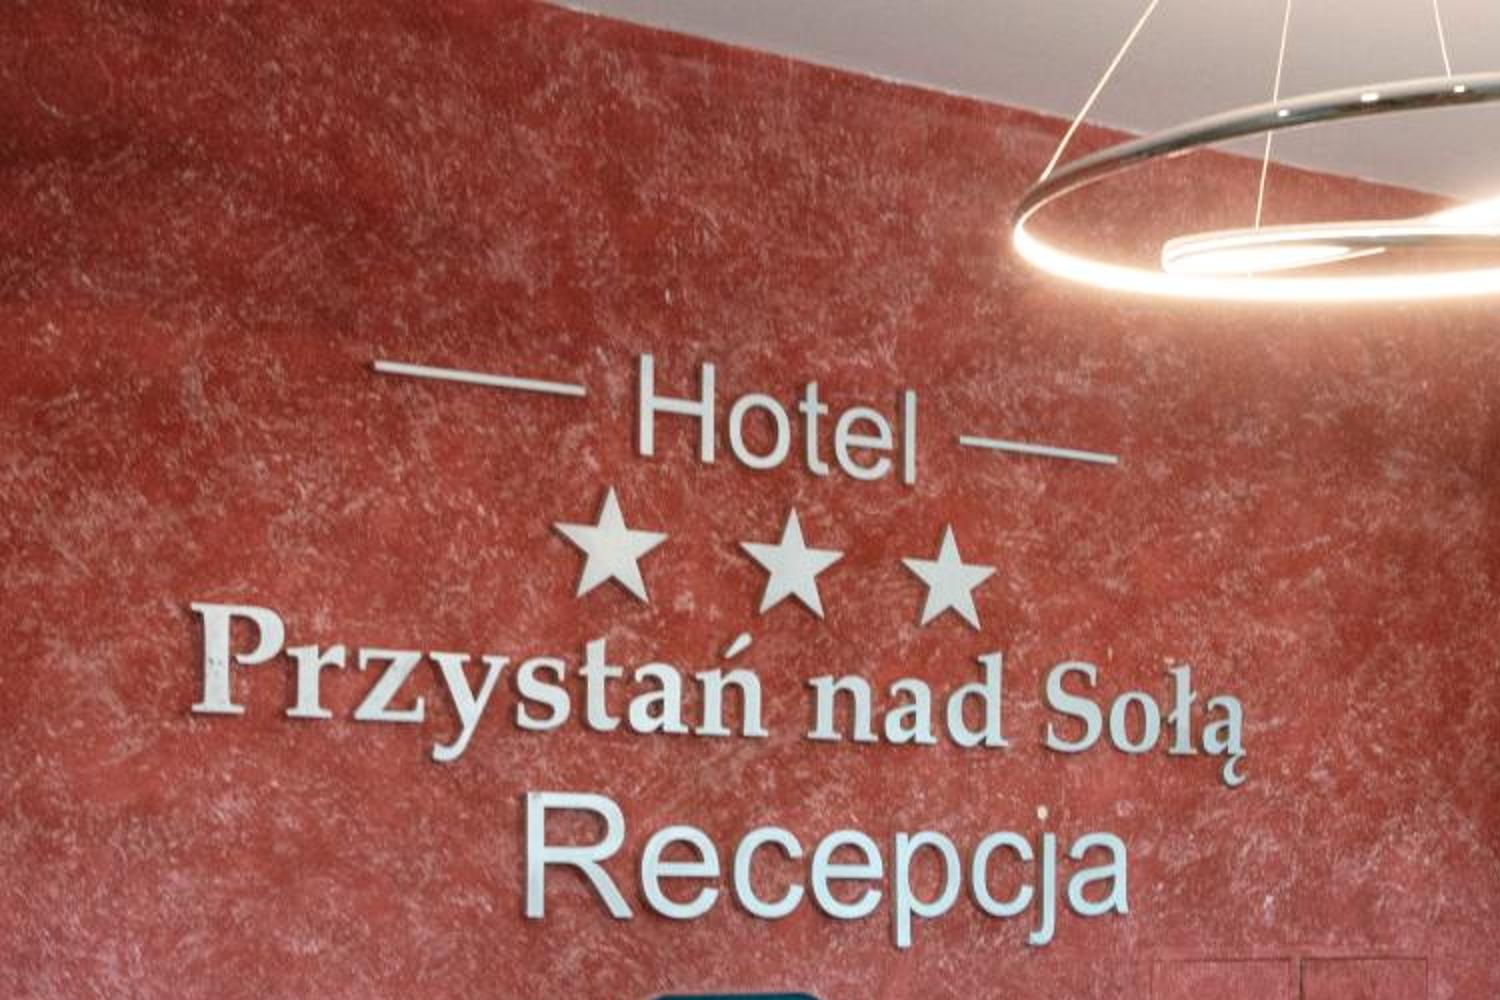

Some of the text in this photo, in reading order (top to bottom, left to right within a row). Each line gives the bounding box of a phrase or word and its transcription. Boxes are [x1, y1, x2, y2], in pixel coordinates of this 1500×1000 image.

[640, 353, 917, 487] Hotel
[190, 601, 1248, 787] Przystań nad Sołą
[525, 790, 1131, 949] Recepcja
